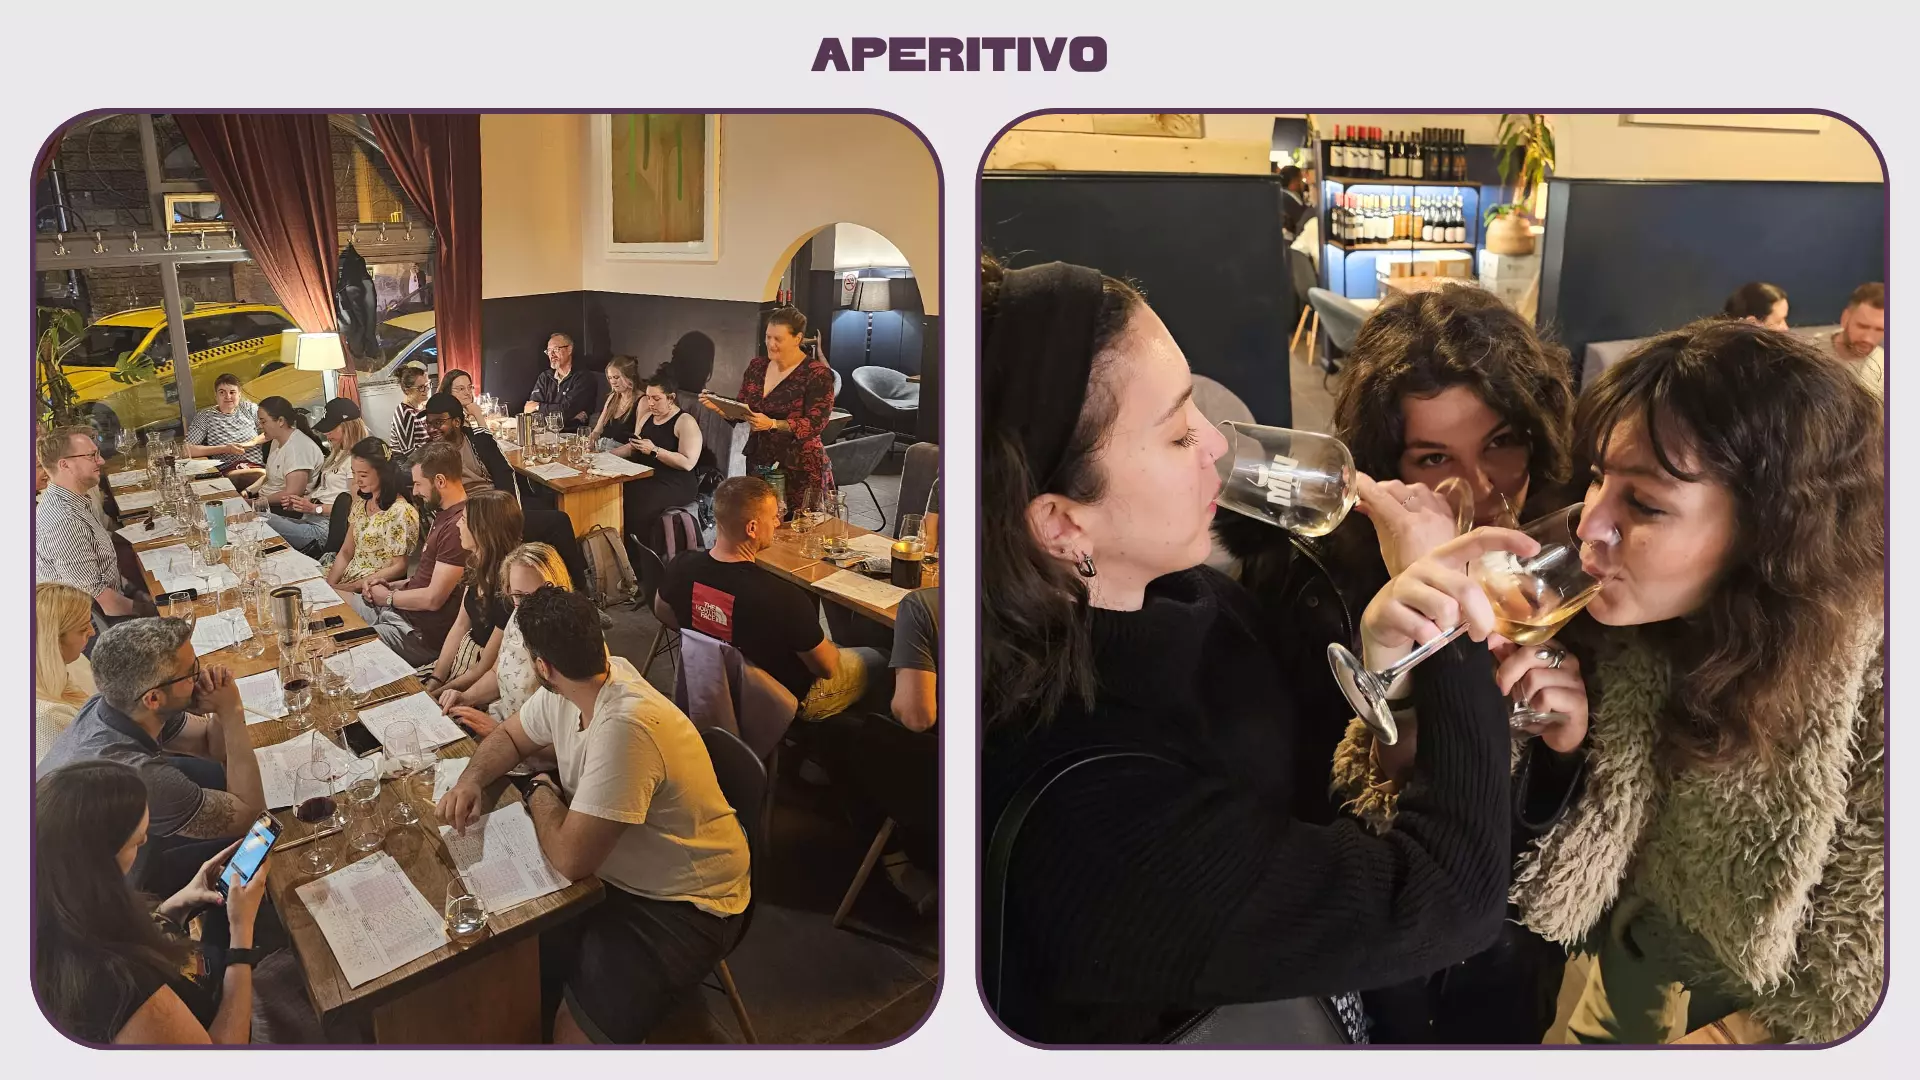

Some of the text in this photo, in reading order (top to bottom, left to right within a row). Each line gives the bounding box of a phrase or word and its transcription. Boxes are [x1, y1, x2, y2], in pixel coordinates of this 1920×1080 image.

[696, 604, 716, 616] NORTH
[704, 602, 716, 611] THE
[701, 612, 716, 622] FACE
